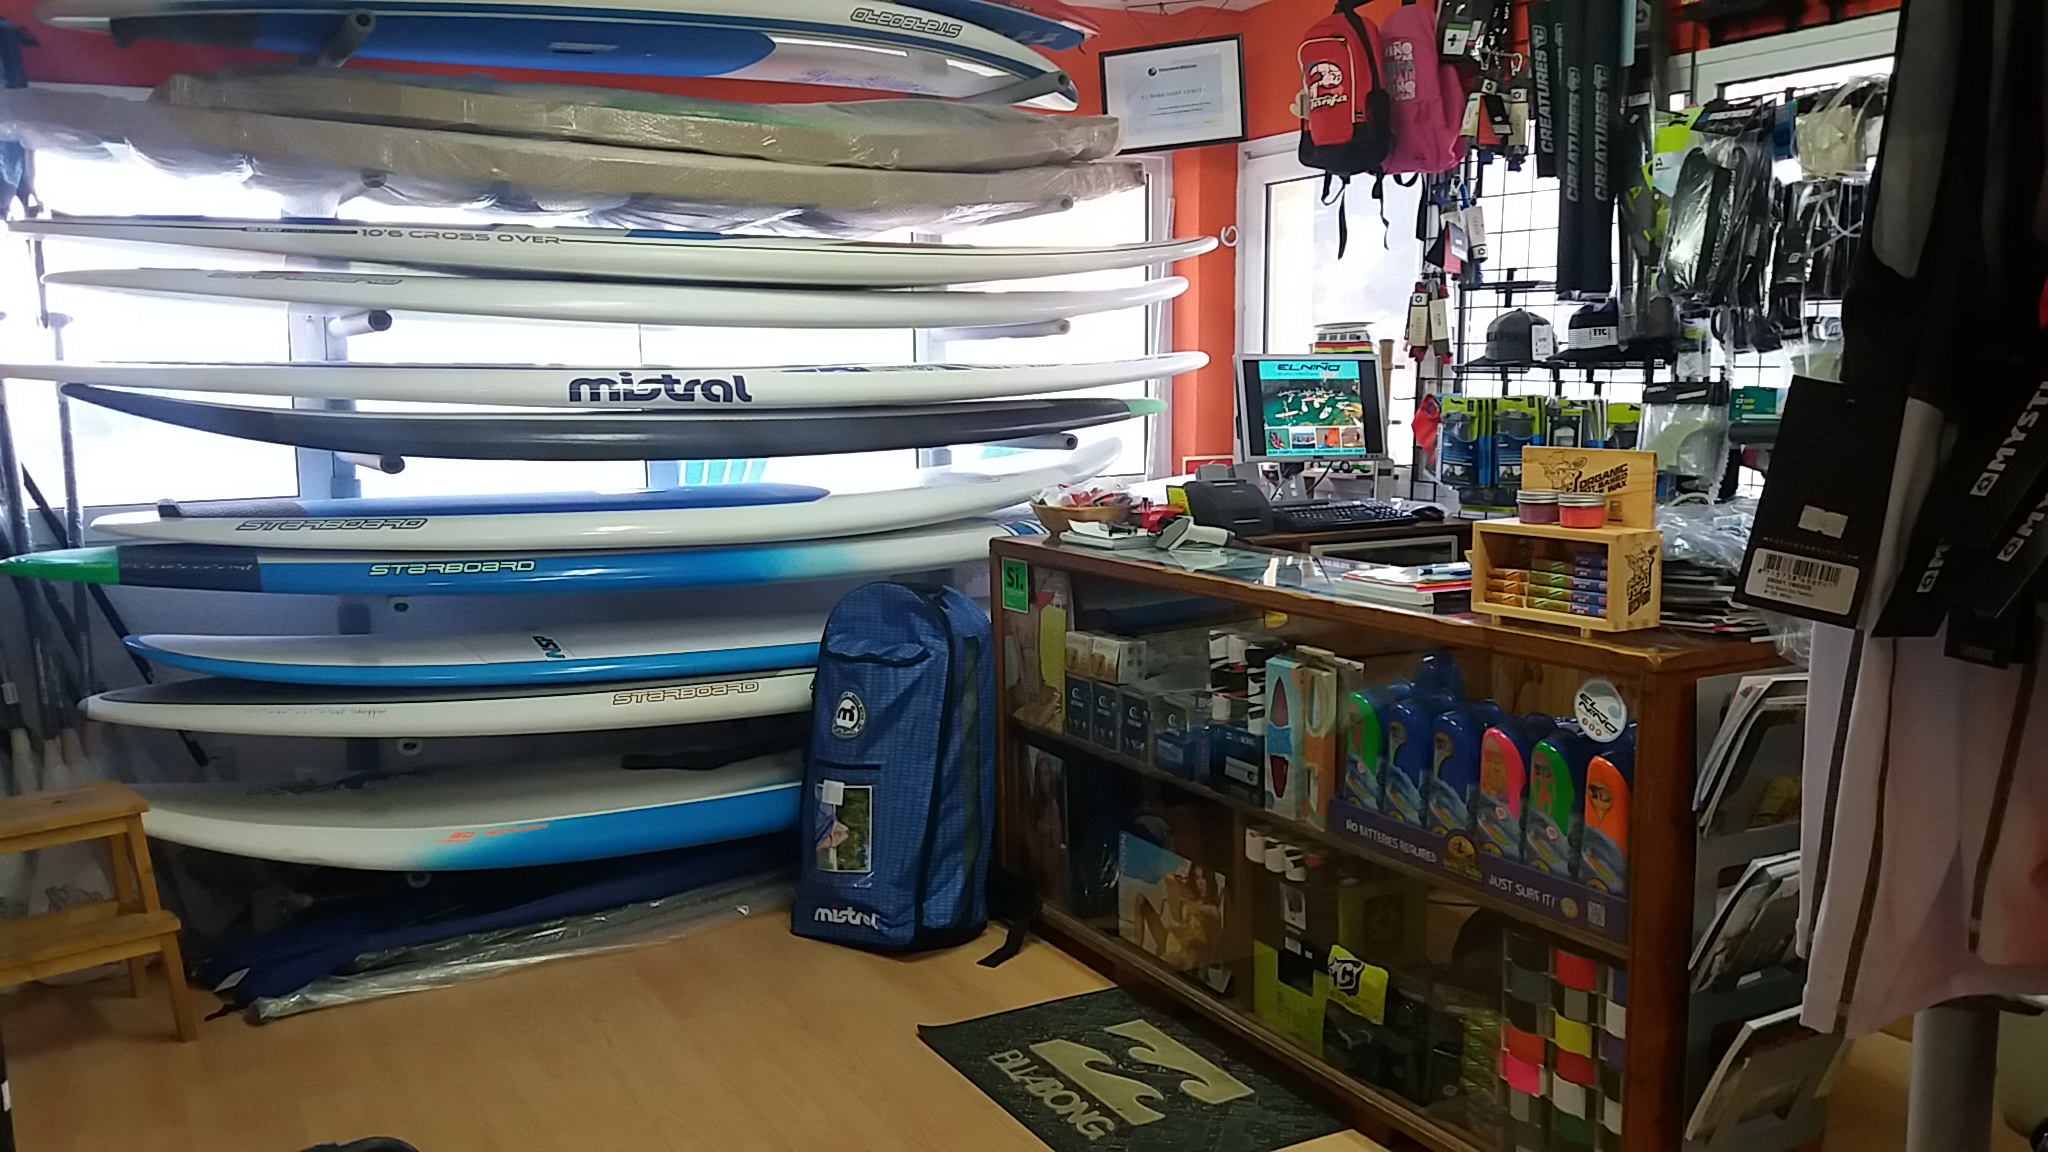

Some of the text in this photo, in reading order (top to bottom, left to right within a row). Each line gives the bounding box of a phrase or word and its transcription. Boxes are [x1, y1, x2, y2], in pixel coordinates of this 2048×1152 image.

[1310, 93, 1348, 111] Tarifa
[1534, 49, 1554, 153] CREATURES
[1566, 92, 1582, 202] CREATURES
[1594, 91, 1609, 201] CREATURES
[362, 228, 403, 238] 10'6
[409, 230, 490, 241] CROSS
[497, 233, 561, 245] OVER
[569, 372, 753, 403] mistral
[1580, 463, 1628, 489] ORGANIC
[1598, 472, 1628, 489] BASED
[1608, 480, 1627, 492] WAX
[234, 517, 428, 531] STARBOARD
[368, 559, 536, 576] STARBOARD
[612, 681, 759, 706] STARBOARD
[1345, 818, 1437, 863] NO BATTERIES REQUIRED
[1488, 874, 1512, 892] JUST
[1515, 882, 1540, 902] SURF
[987, 1049, 1115, 1140] BILLABONG
